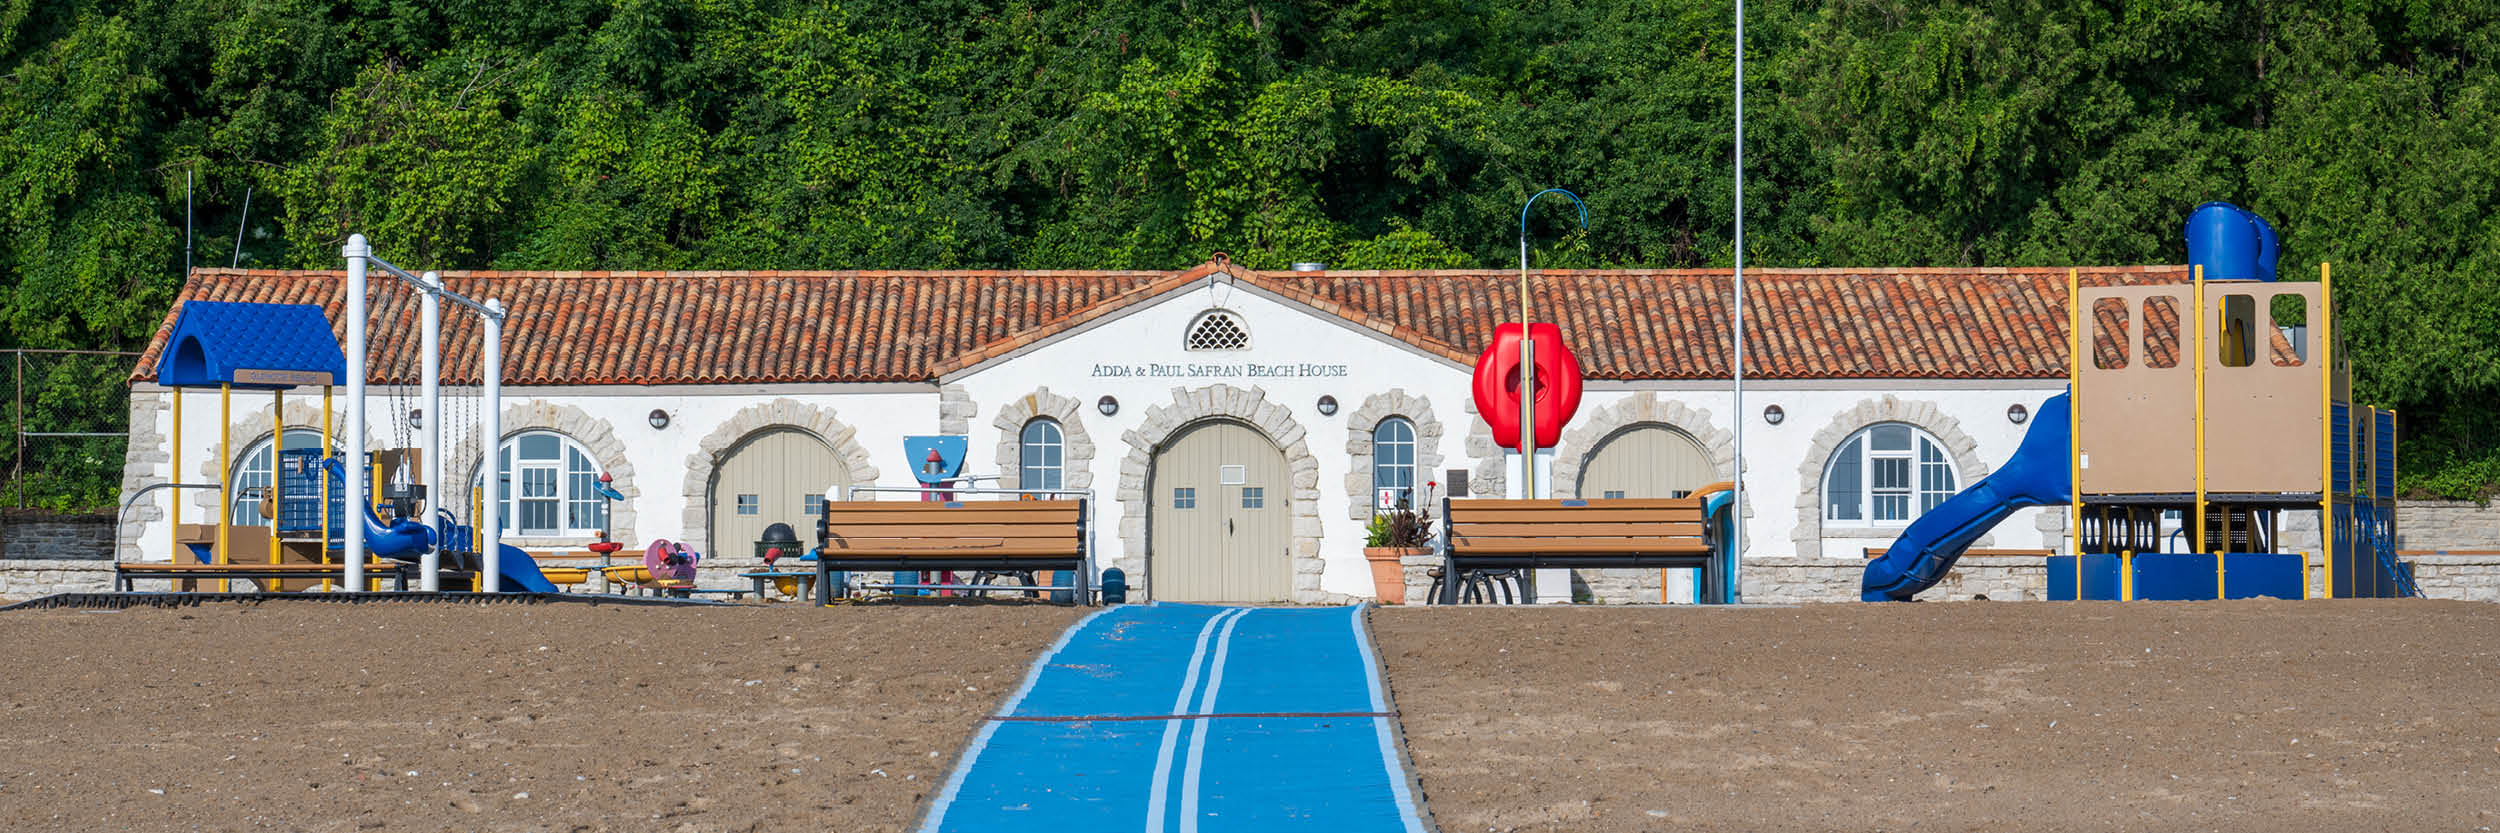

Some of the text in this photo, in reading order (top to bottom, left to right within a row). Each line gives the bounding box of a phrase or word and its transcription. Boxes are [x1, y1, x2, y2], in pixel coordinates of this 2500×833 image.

[1091, 364, 1348, 377] ADDA & PAUL SAFRAN BEACH HOUSE
